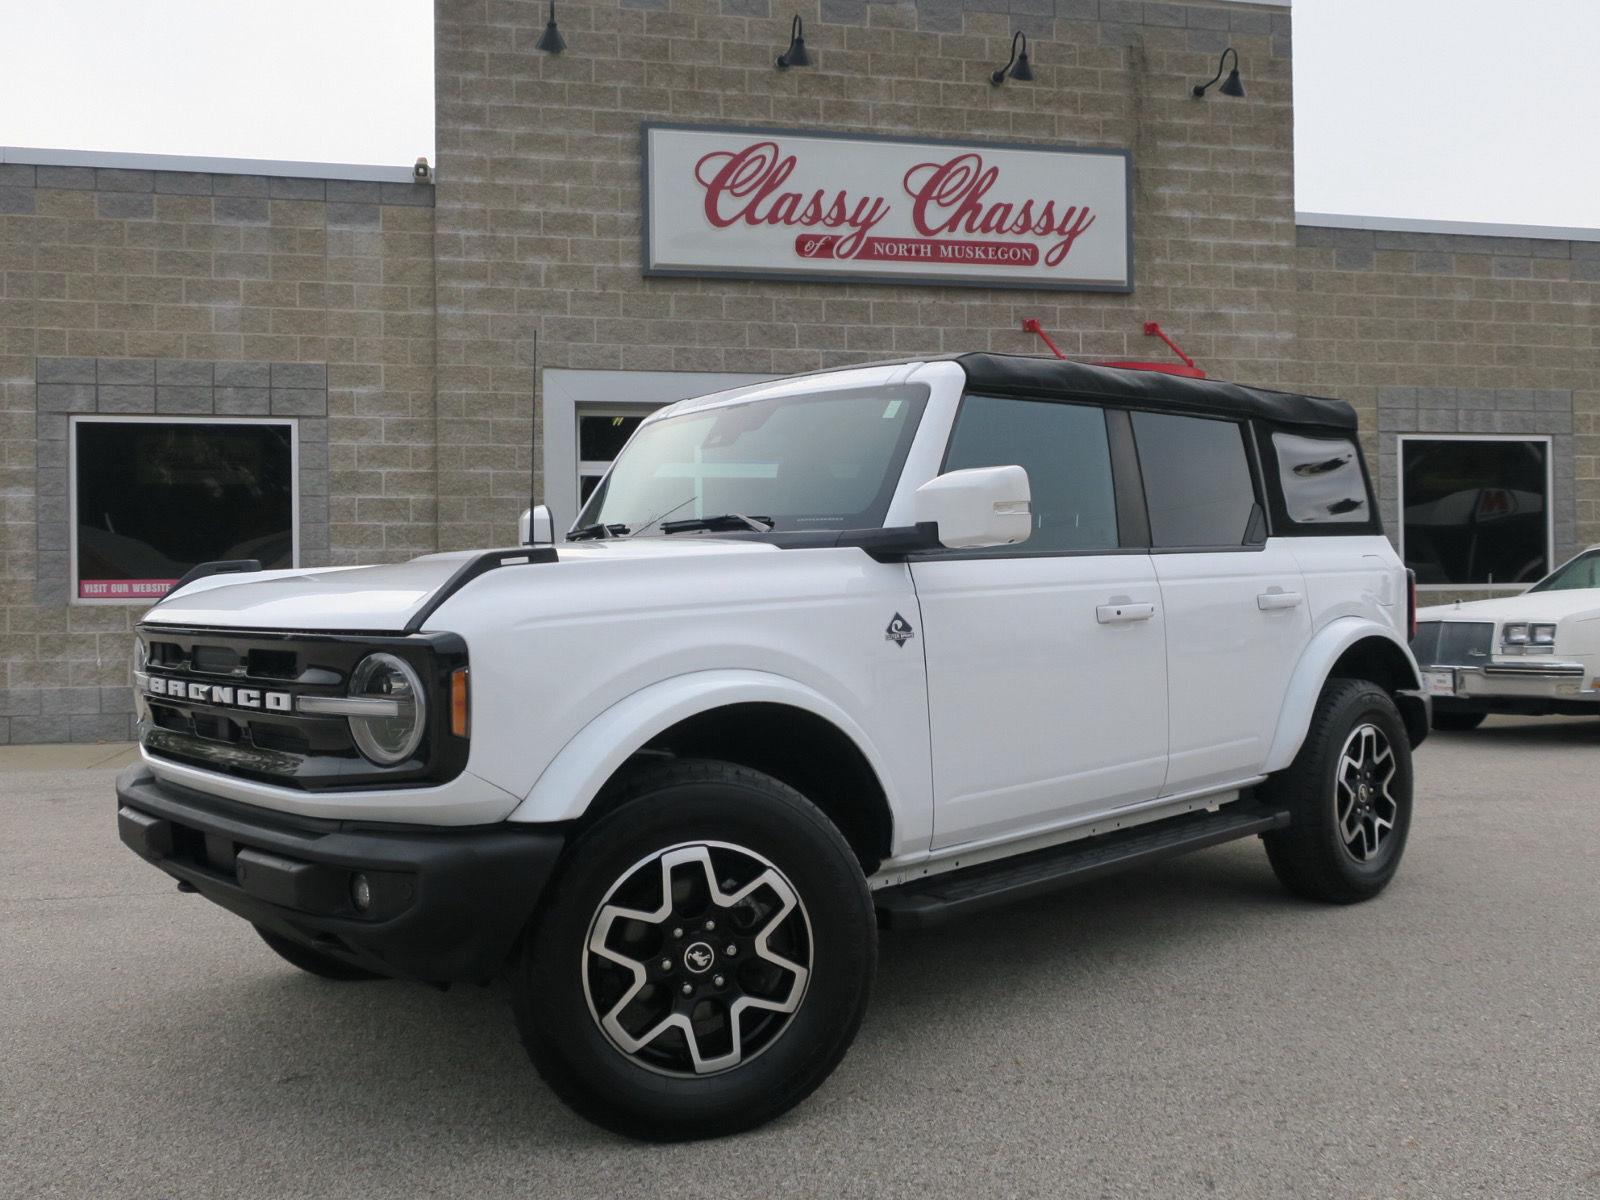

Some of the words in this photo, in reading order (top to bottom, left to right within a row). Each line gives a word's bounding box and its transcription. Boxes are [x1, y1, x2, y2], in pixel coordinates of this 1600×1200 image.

[695, 142, 890, 259] Classy
[904, 153, 1096, 267] Chassy
[804, 235, 831, 256] of
[873, 242, 932, 257] NORTH
[940, 244, 1032, 261] MUSKEGON
[84, 583, 107, 593] VISIT
[111, 583, 129, 593] OUR
[132, 583, 171, 593] WEBSITE
[149, 678, 291, 710] BRONCO
